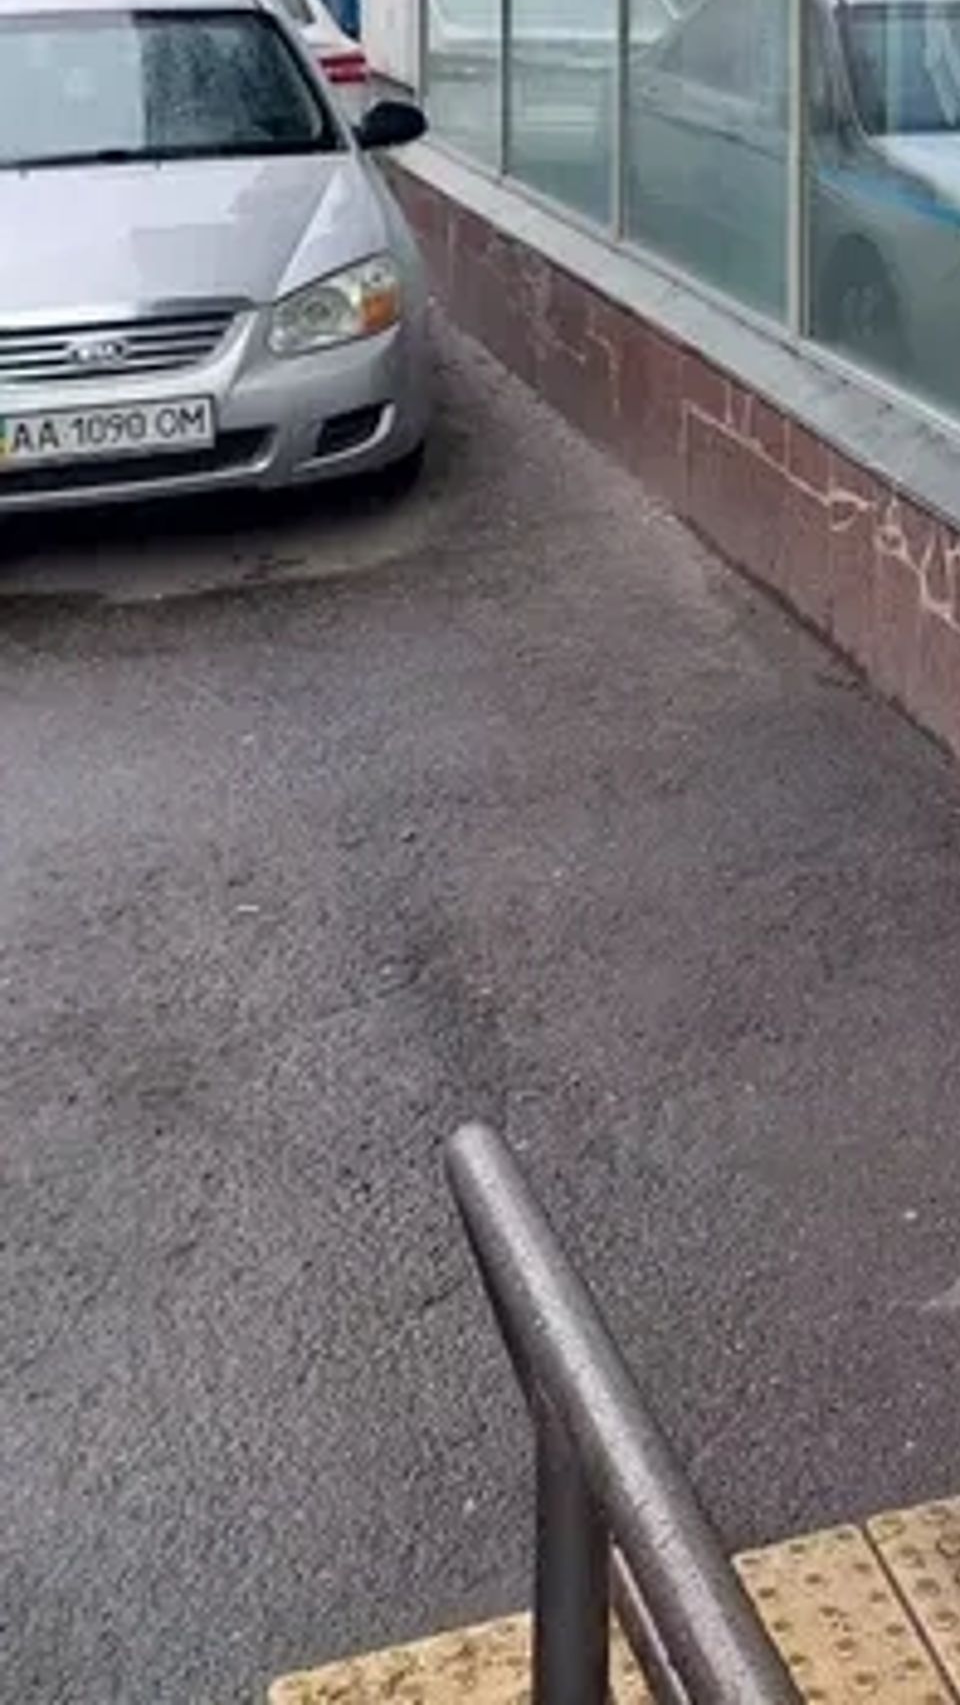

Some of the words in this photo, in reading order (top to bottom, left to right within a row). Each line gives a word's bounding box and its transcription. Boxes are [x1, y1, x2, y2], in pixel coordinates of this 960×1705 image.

[11, 419, 60, 452] AA
[69, 411, 148, 445] 1090
[155, 403, 206, 437] OM
